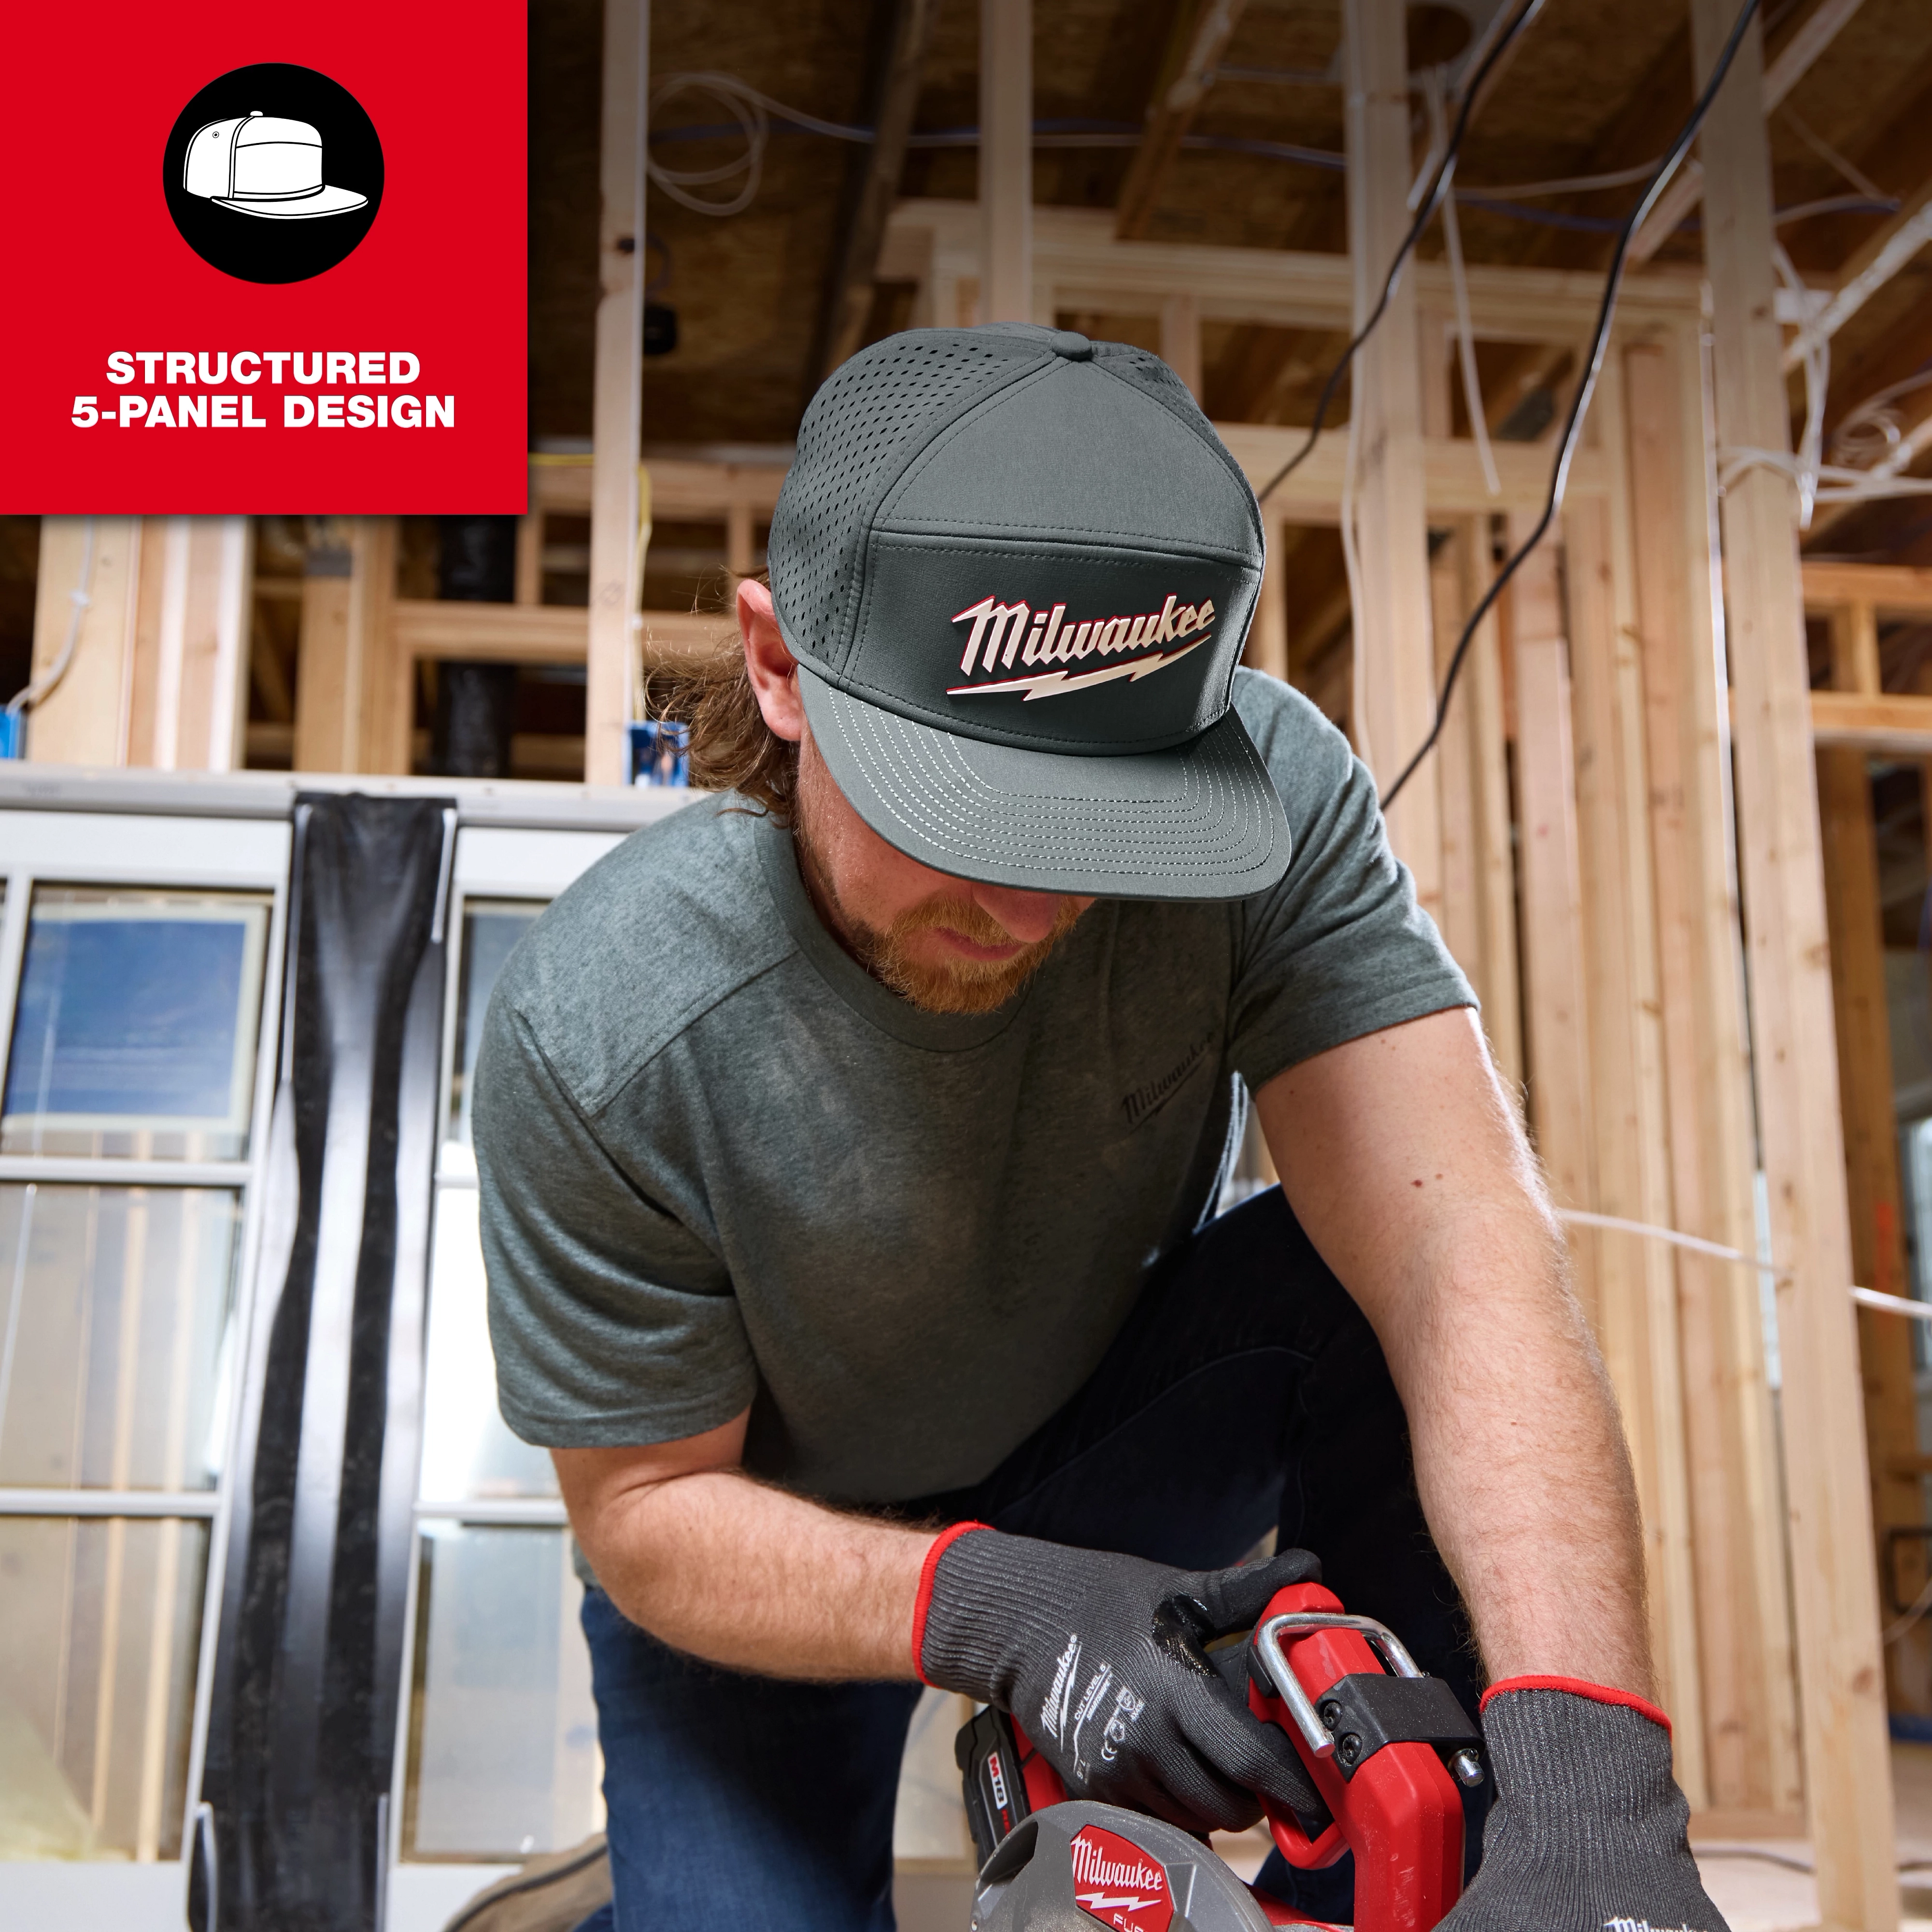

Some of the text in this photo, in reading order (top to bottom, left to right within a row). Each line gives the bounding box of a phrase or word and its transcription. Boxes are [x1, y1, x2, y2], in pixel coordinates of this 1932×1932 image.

[951, 594, 1216, 677] Milwaukee
[1074, 1701, 1085, 1720] CUT
[1083, 1675, 1101, 1702] LEVEL
[990, 1756, 1004, 1803] M18
[1070, 1835, 1163, 1890] Milwaukee
